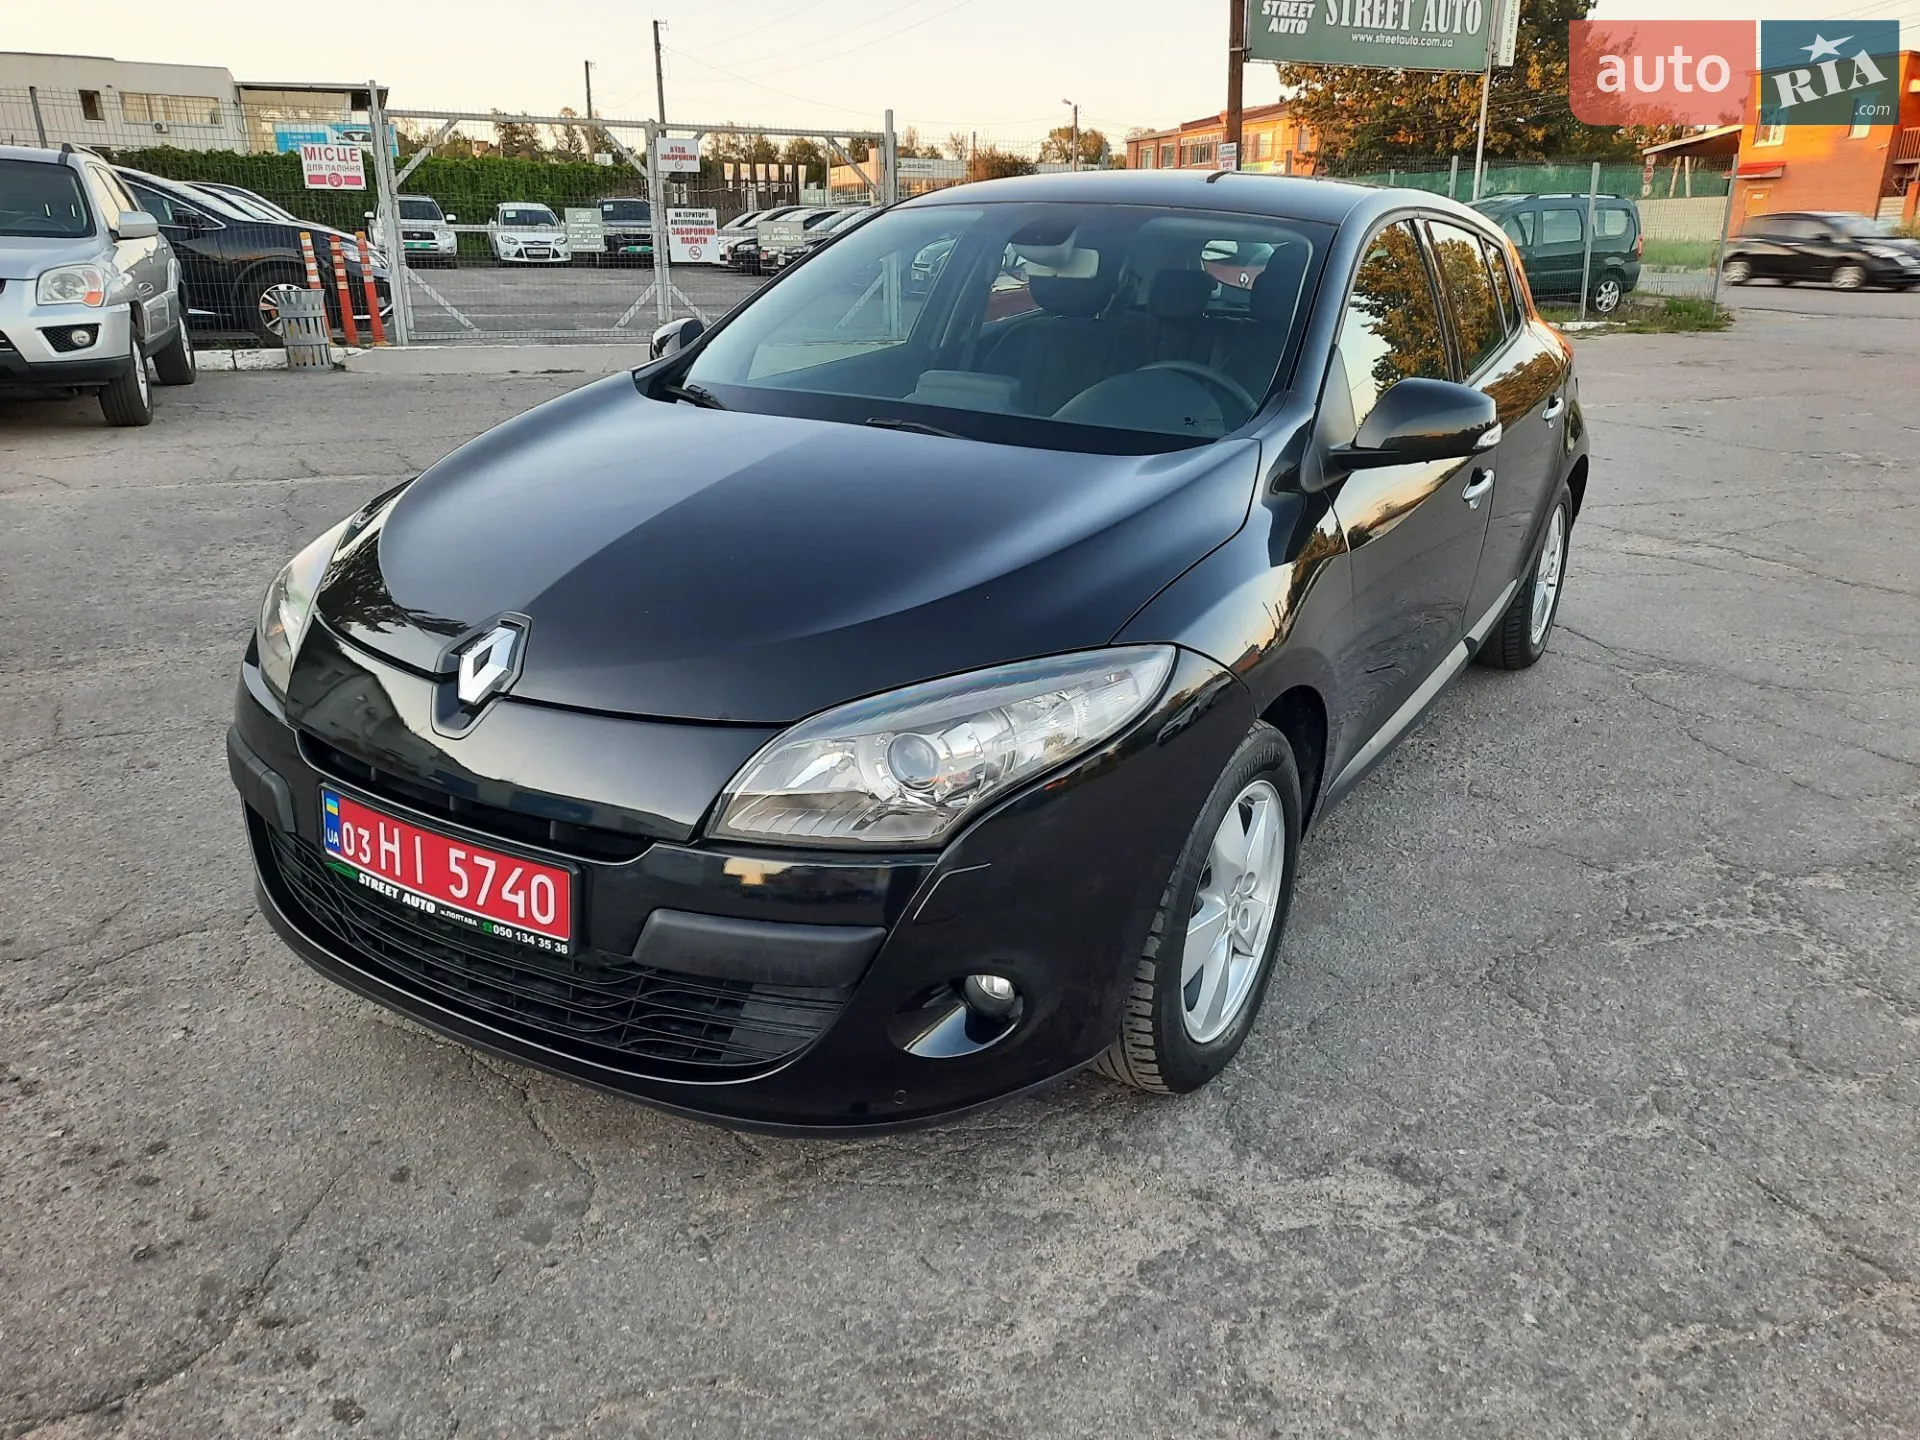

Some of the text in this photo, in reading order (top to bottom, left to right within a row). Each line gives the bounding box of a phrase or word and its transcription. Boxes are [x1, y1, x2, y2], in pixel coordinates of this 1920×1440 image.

[1261, 0, 1317, 19] STREET
[1325, 0, 1482, 35] STREET AUTO
[1267, 17, 1308, 35] AUTO
[1351, 32, 1453, 48] www.streetauto.com.ua
[303, 146, 359, 164] МІСЦЕ
[306, 164, 323, 172] ДЛЯ
[671, 227, 715, 236] ЗАБОРОНЕНО
[680, 236, 708, 245] ПАЛИТИ
[327, 827, 340, 847] UA
[448, 847, 555, 926] 5740
[358, 872, 399, 899] STREET
[401, 892, 436, 914] AUTO
[493, 924, 513, 938] 050
[515, 931, 535, 945] 134
[538, 937, 552, 950] 35
[554, 942, 568, 955] 38
